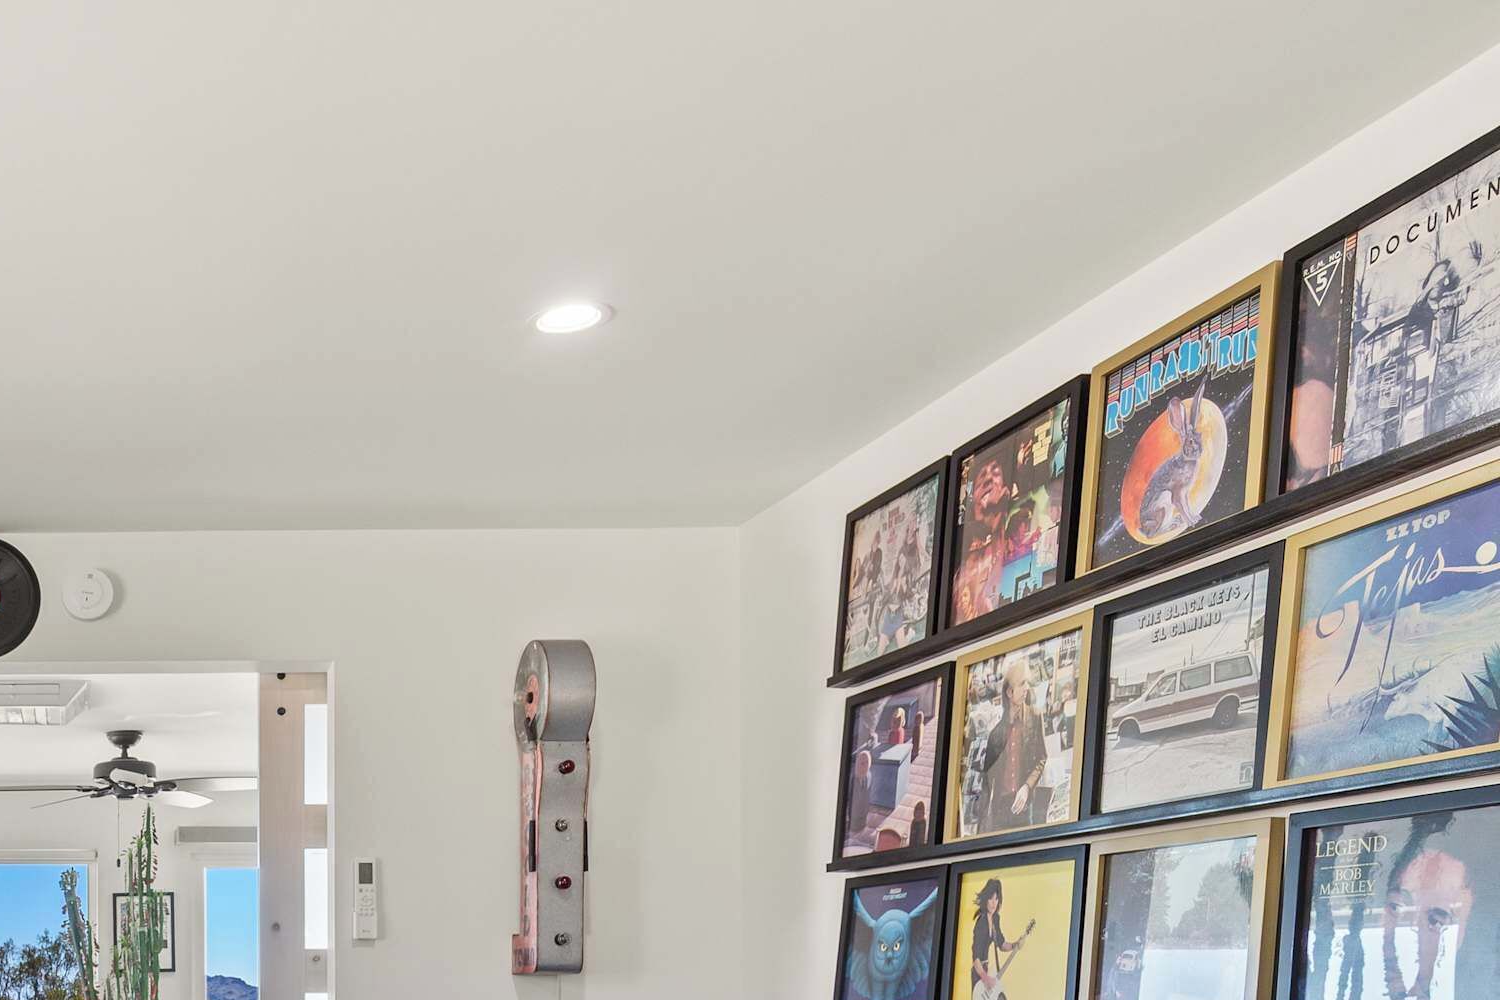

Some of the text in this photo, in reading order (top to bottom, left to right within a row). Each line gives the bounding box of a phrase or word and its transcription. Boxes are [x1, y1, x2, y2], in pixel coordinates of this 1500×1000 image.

[1315, 270, 1328, 293] 5
[1385, 509, 1451, 542] ZZ TOP
[1138, 583, 1241, 629] THE BLACK KEYS
[1151, 608, 1222, 643] EL CAMINO
[1315, 835, 1388, 858] LEGEND
[1335, 867, 1362, 881] BOB
[1320, 880, 1376, 895] MARLEY
